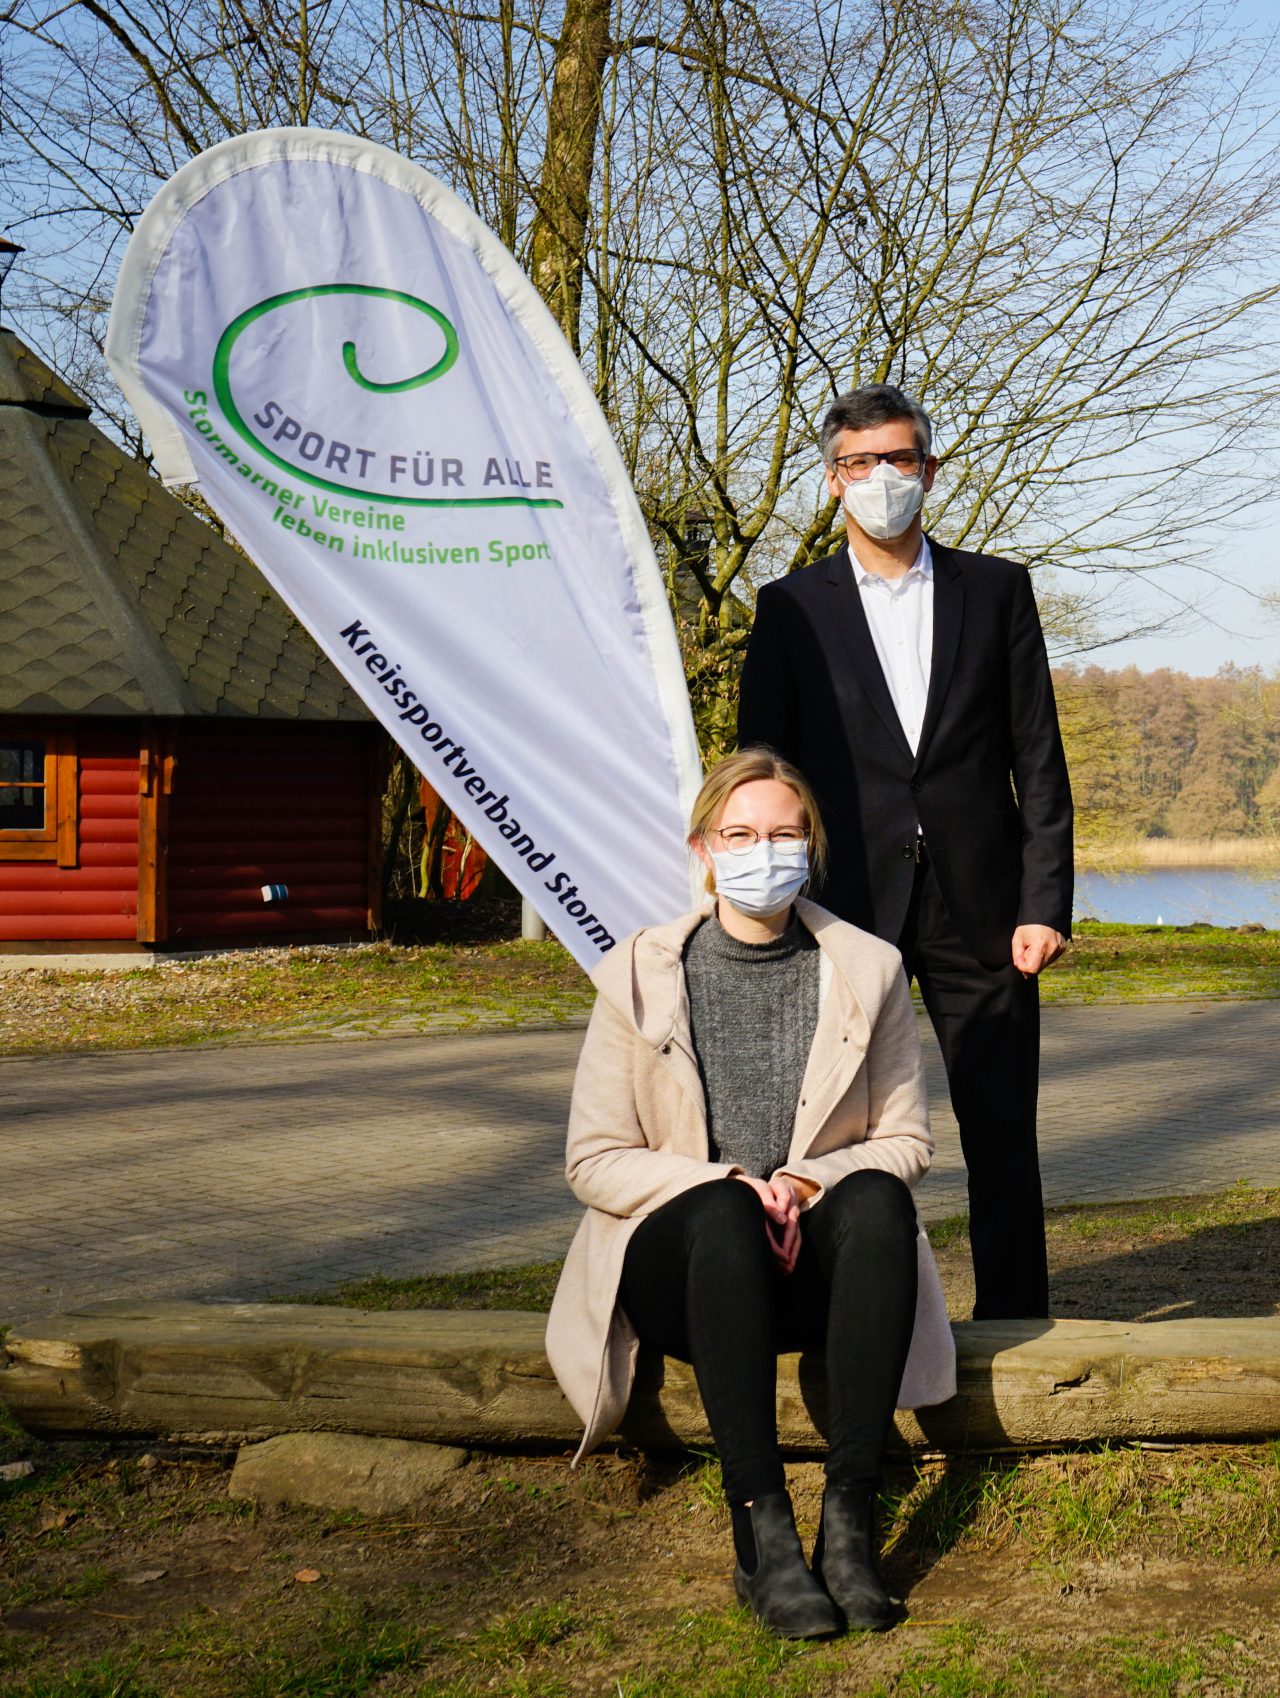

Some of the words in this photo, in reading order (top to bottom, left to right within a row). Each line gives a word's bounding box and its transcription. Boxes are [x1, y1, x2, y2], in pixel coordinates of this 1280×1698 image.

[184, 389, 305, 510] Stormarner
[311, 495, 406, 532] Vereine
[254, 401, 377, 479] SPORT
[389, 450, 466, 487] FÜR
[482, 457, 554, 489] ALLE
[272, 505, 345, 554] leben
[352, 535, 481, 565] inklusiven
[488, 539, 552, 568] Sport
[339, 619, 557, 873] Kreissportverband
[544, 871, 617, 954] Storm
